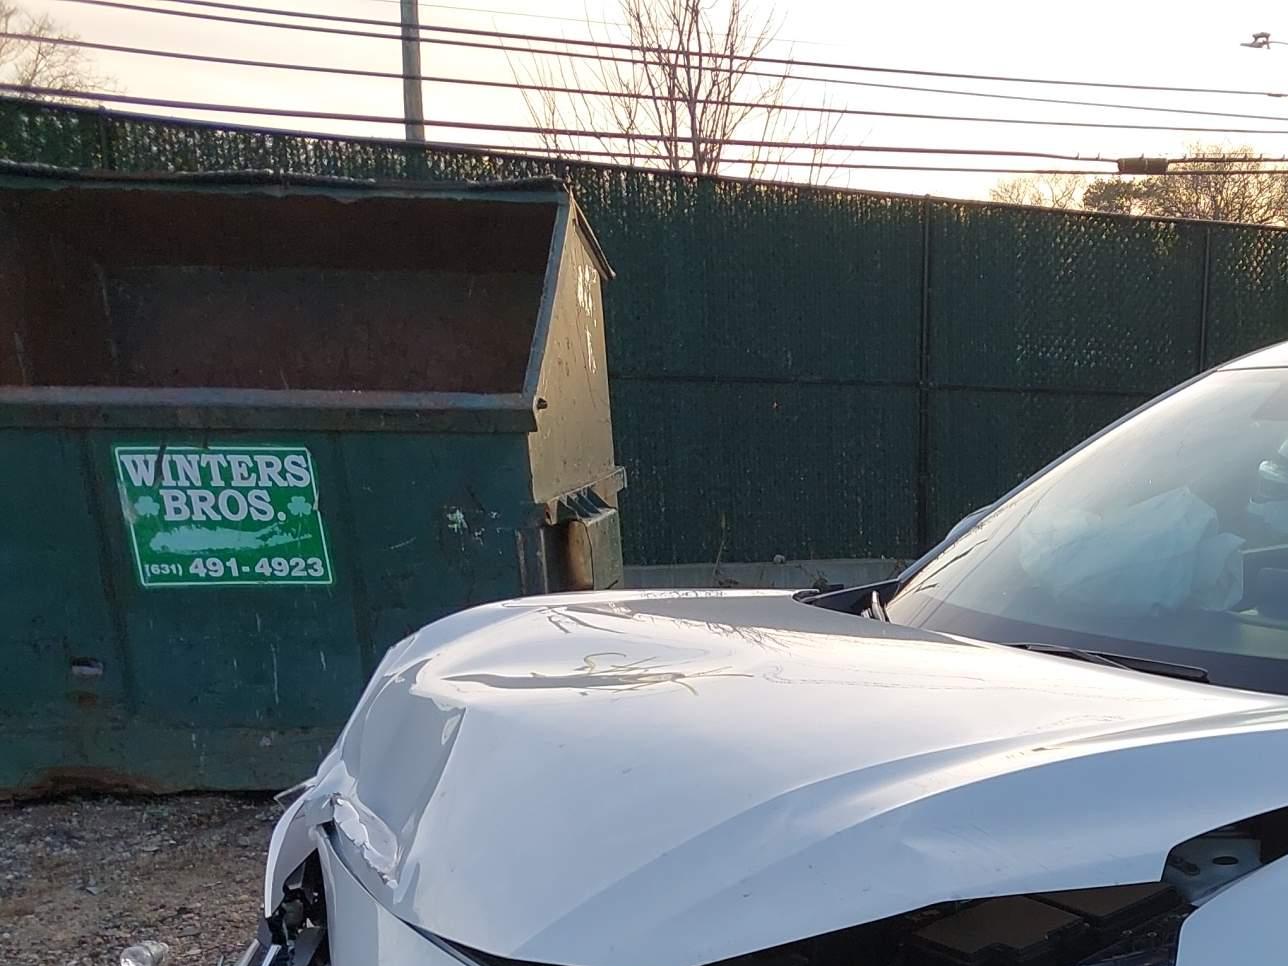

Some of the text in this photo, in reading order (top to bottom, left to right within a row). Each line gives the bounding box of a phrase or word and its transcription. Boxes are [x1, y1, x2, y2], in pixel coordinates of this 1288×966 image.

[120, 454, 311, 487] WINTERS
[159, 489, 287, 522] BROS.
[143, 557, 325, 577] (631) 491-4923
